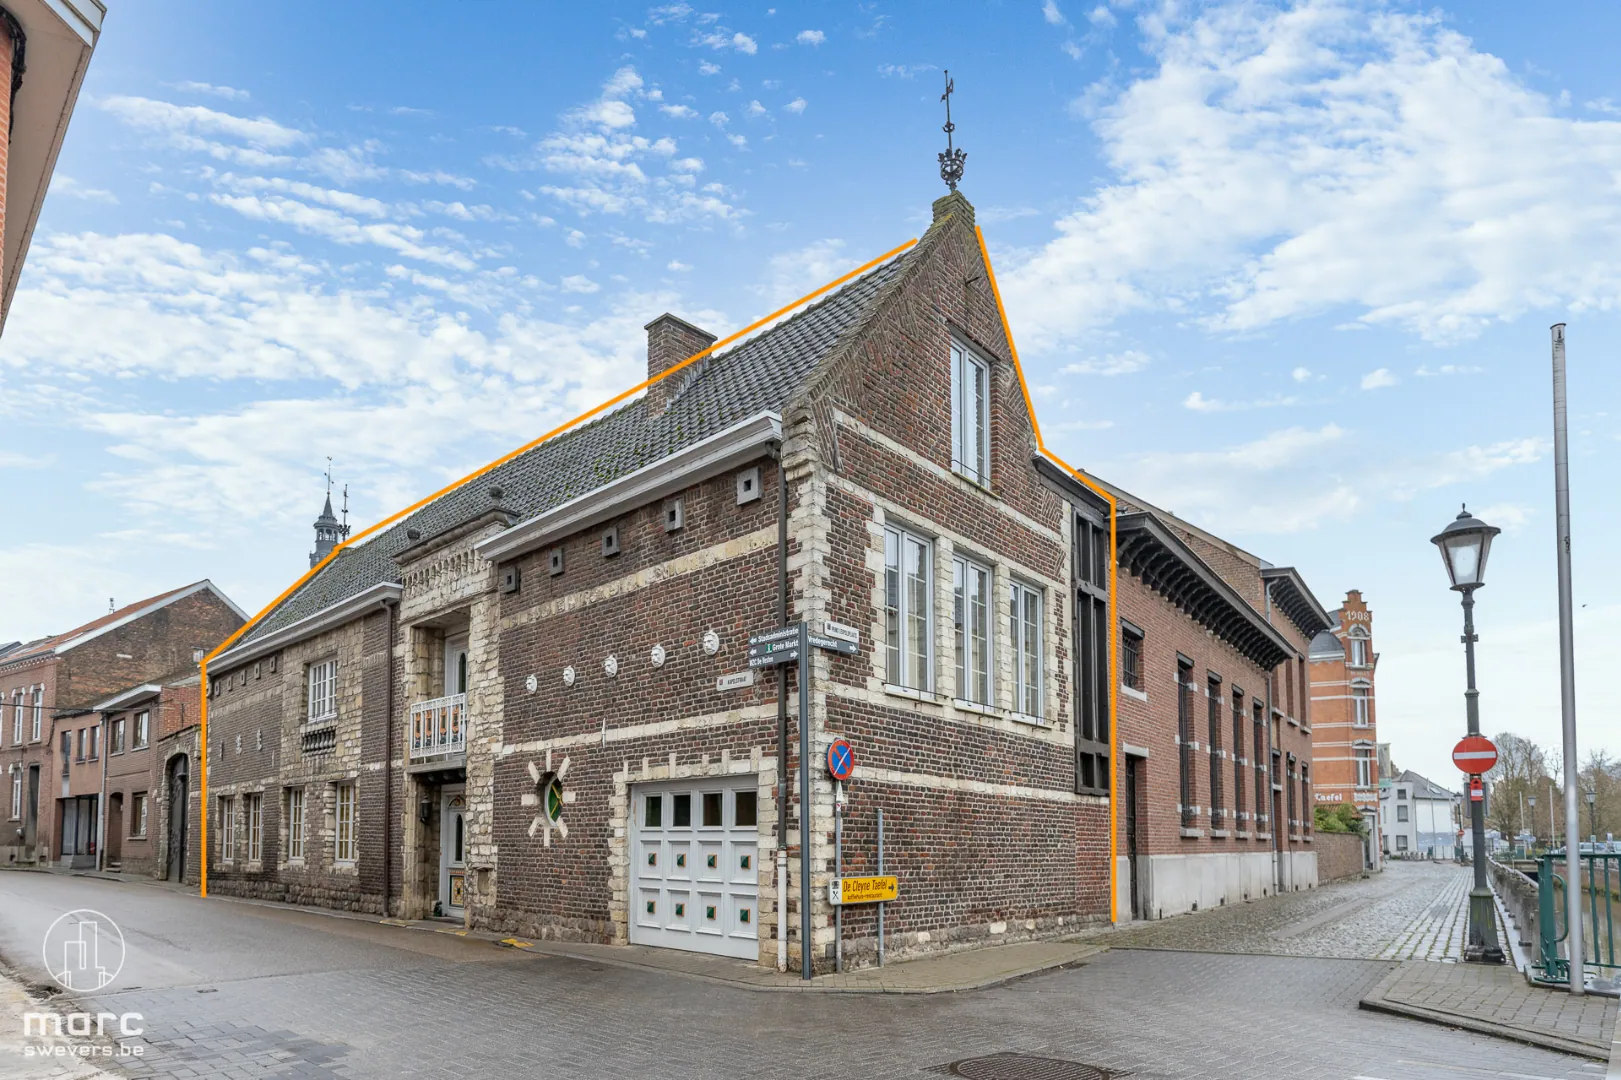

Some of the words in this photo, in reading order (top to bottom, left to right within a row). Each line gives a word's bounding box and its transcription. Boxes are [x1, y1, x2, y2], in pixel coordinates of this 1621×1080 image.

[1345, 611, 1369, 621] 1908
[758, 628, 799, 643] Stadsadministratie
[807, 635, 838, 648] Vredegerecht
[772, 642, 785, 651] Grote
[785, 640, 799, 649] Markt
[843, 881, 851, 892] De
[852, 880, 871, 893] Cleyne
[872, 879, 887, 890] Taefel
